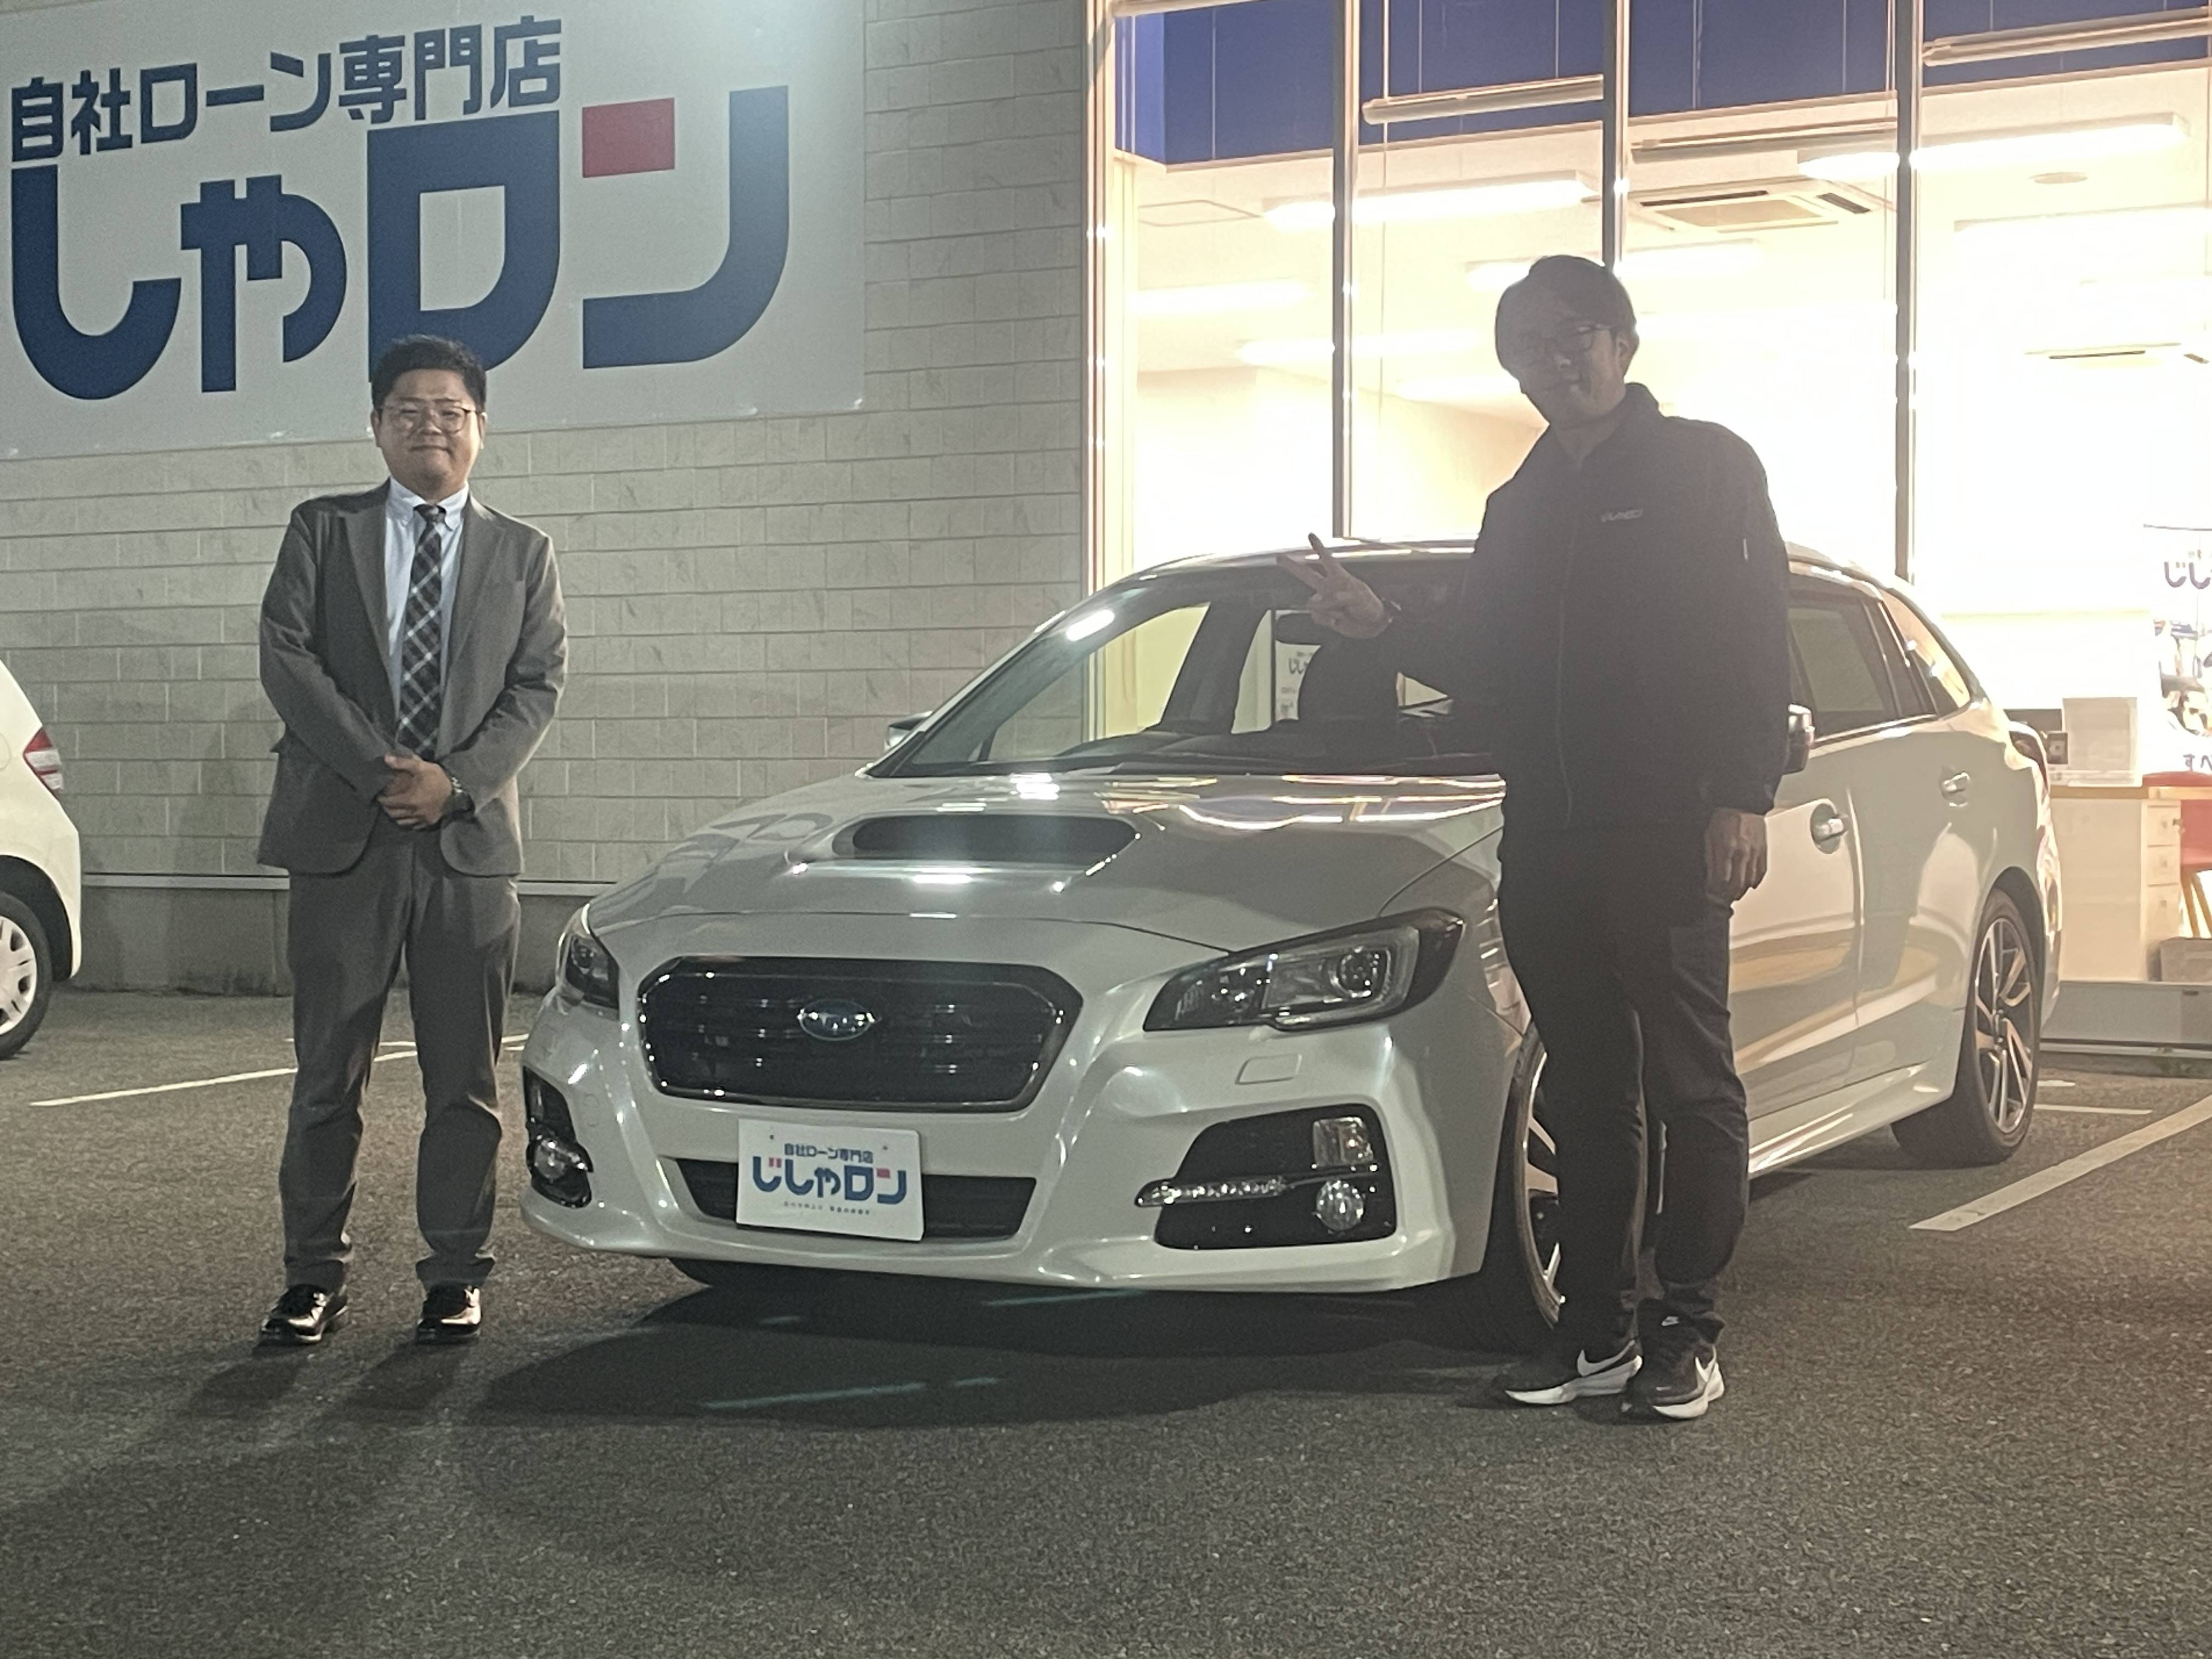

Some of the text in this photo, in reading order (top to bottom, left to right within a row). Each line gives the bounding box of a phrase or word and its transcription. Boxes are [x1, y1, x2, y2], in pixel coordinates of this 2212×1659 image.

[11, 15, 562, 162] 自社ローン専門店
[2164, 561, 2212, 589] じし
[752, 1156, 907, 1205] じしゃロン
